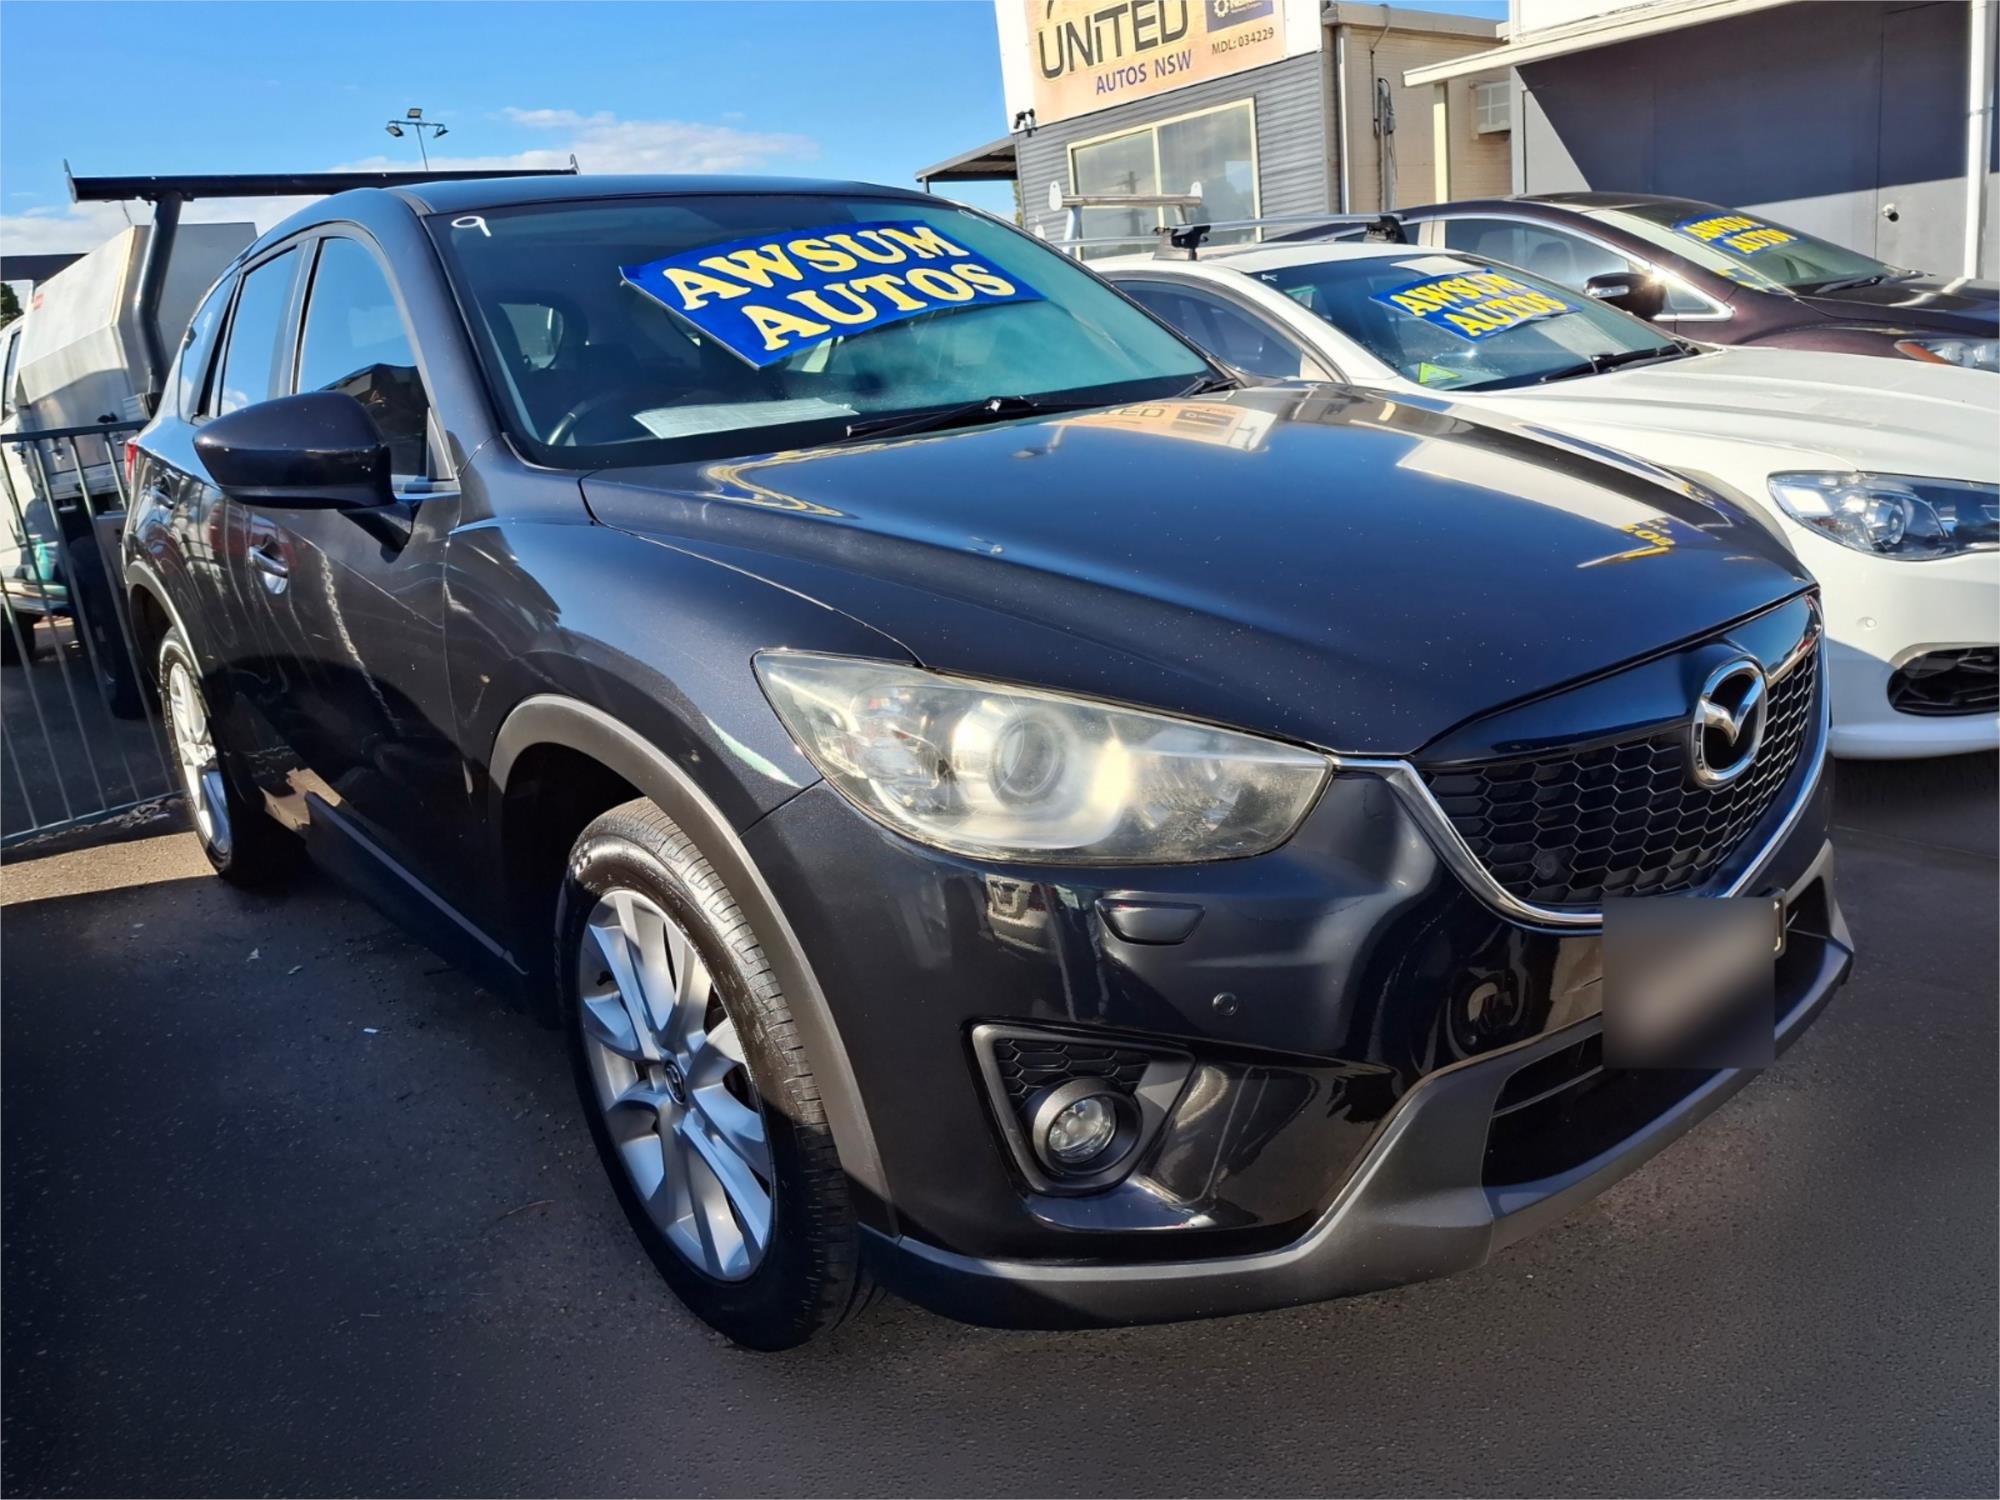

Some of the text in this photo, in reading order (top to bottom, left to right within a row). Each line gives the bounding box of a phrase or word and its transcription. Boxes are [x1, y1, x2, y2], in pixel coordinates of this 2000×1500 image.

[1211, 26, 1274, 55] MDL: 034229
[1096, 48, 1192, 95] AUTOS NSW
[662, 225, 971, 311] AWSUM
[740, 262, 1017, 352] AUTOS
[1390, 273, 1527, 317] AWSUM
[1443, 291, 1568, 337] AUTOS
